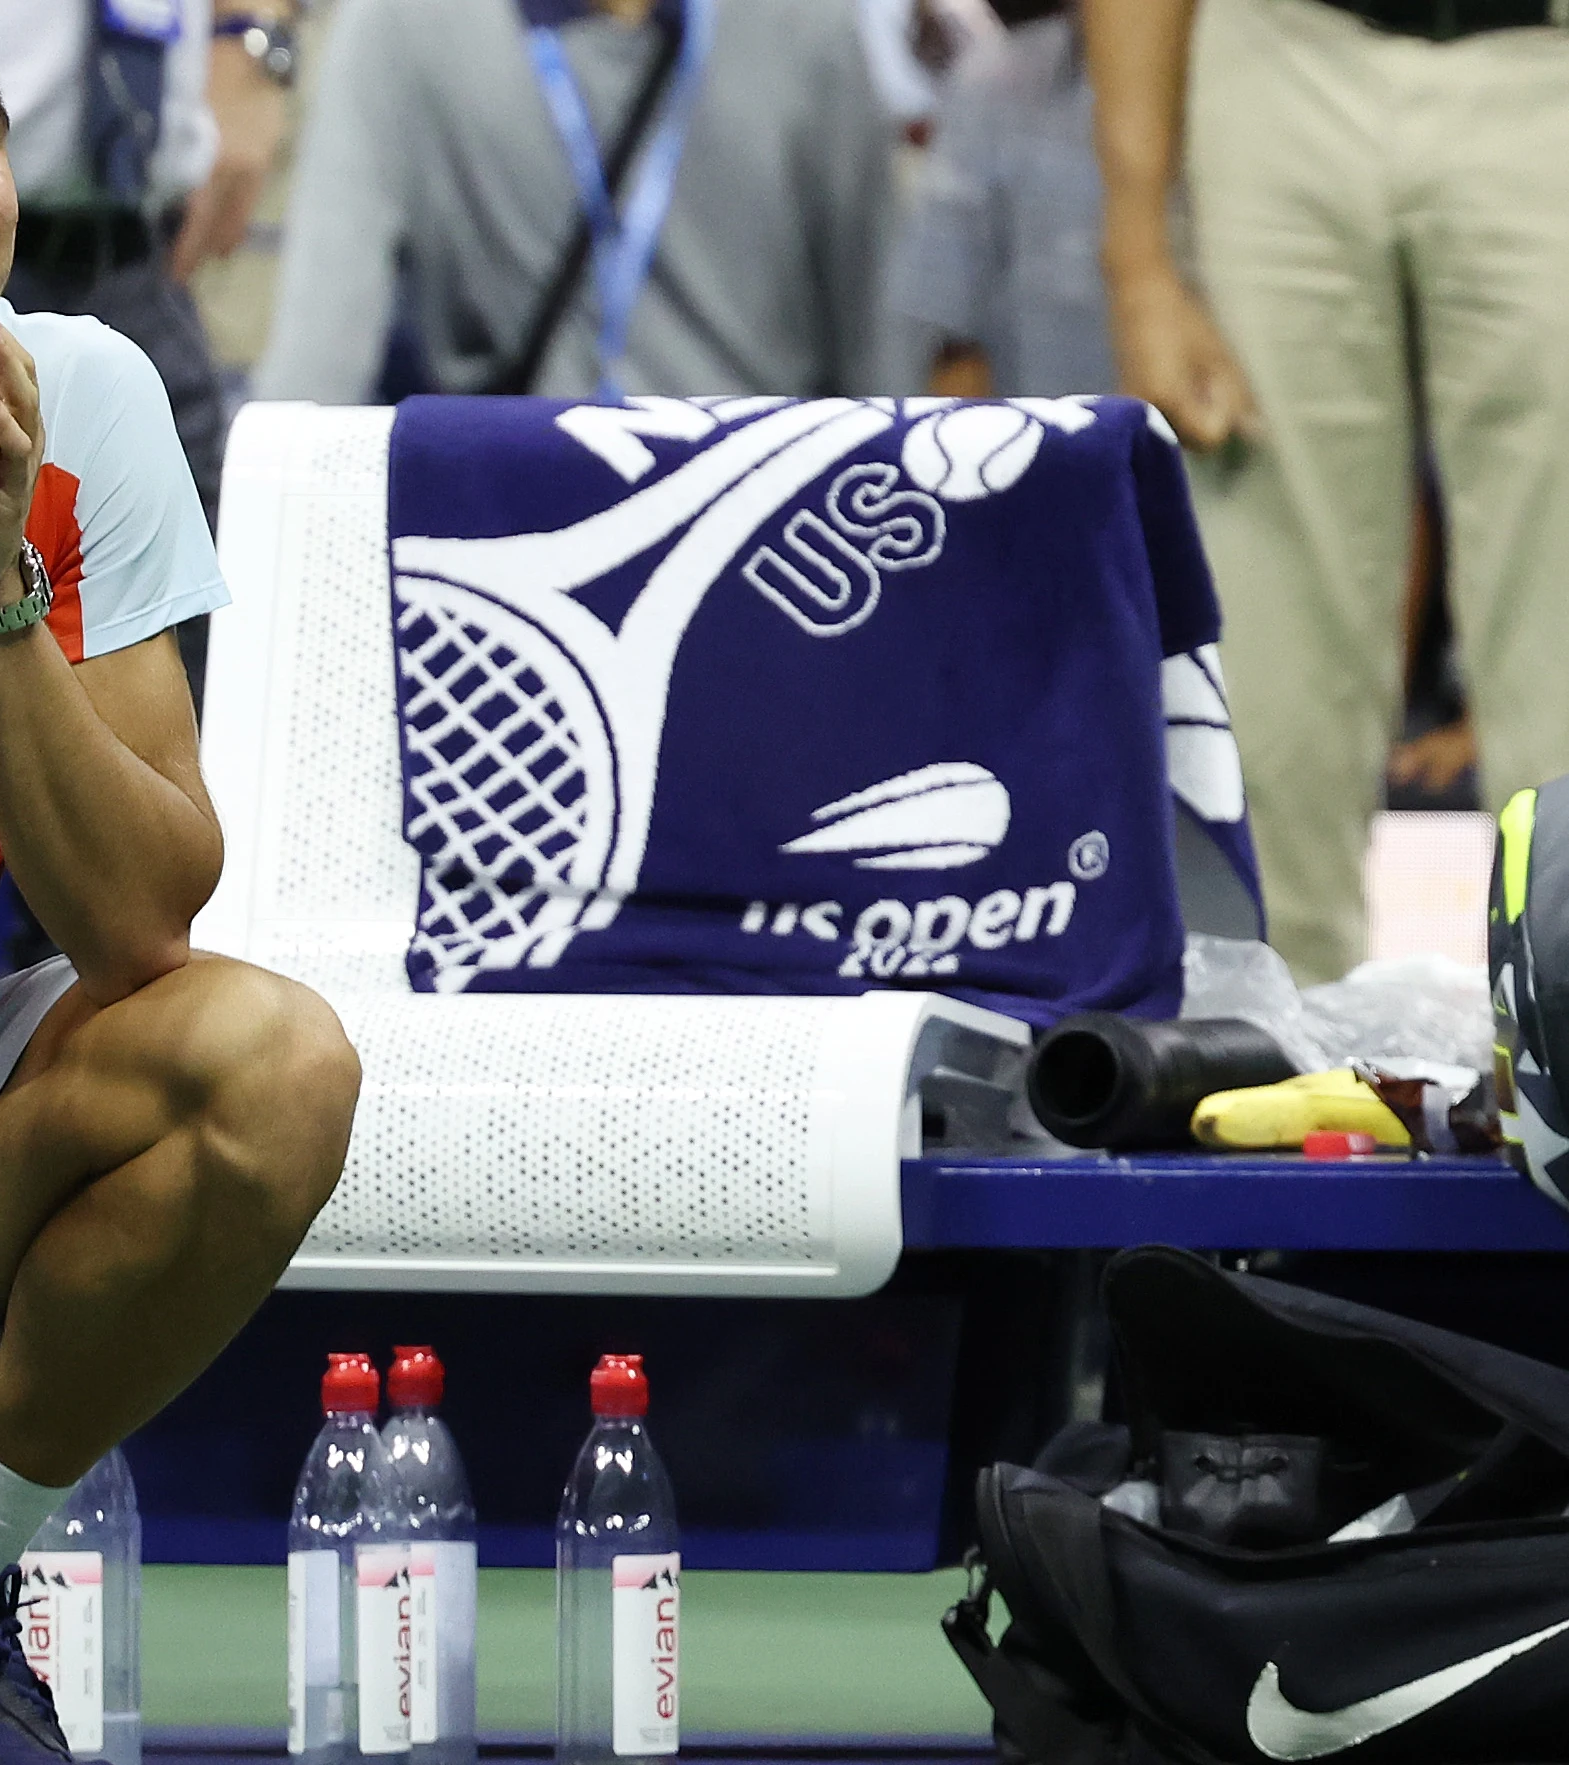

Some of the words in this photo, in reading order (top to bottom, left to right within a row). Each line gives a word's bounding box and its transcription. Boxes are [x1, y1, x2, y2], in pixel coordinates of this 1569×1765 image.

[741, 462, 948, 637] US
[853, 880, 1077, 955] open
[652, 1596, 677, 1719] evian
